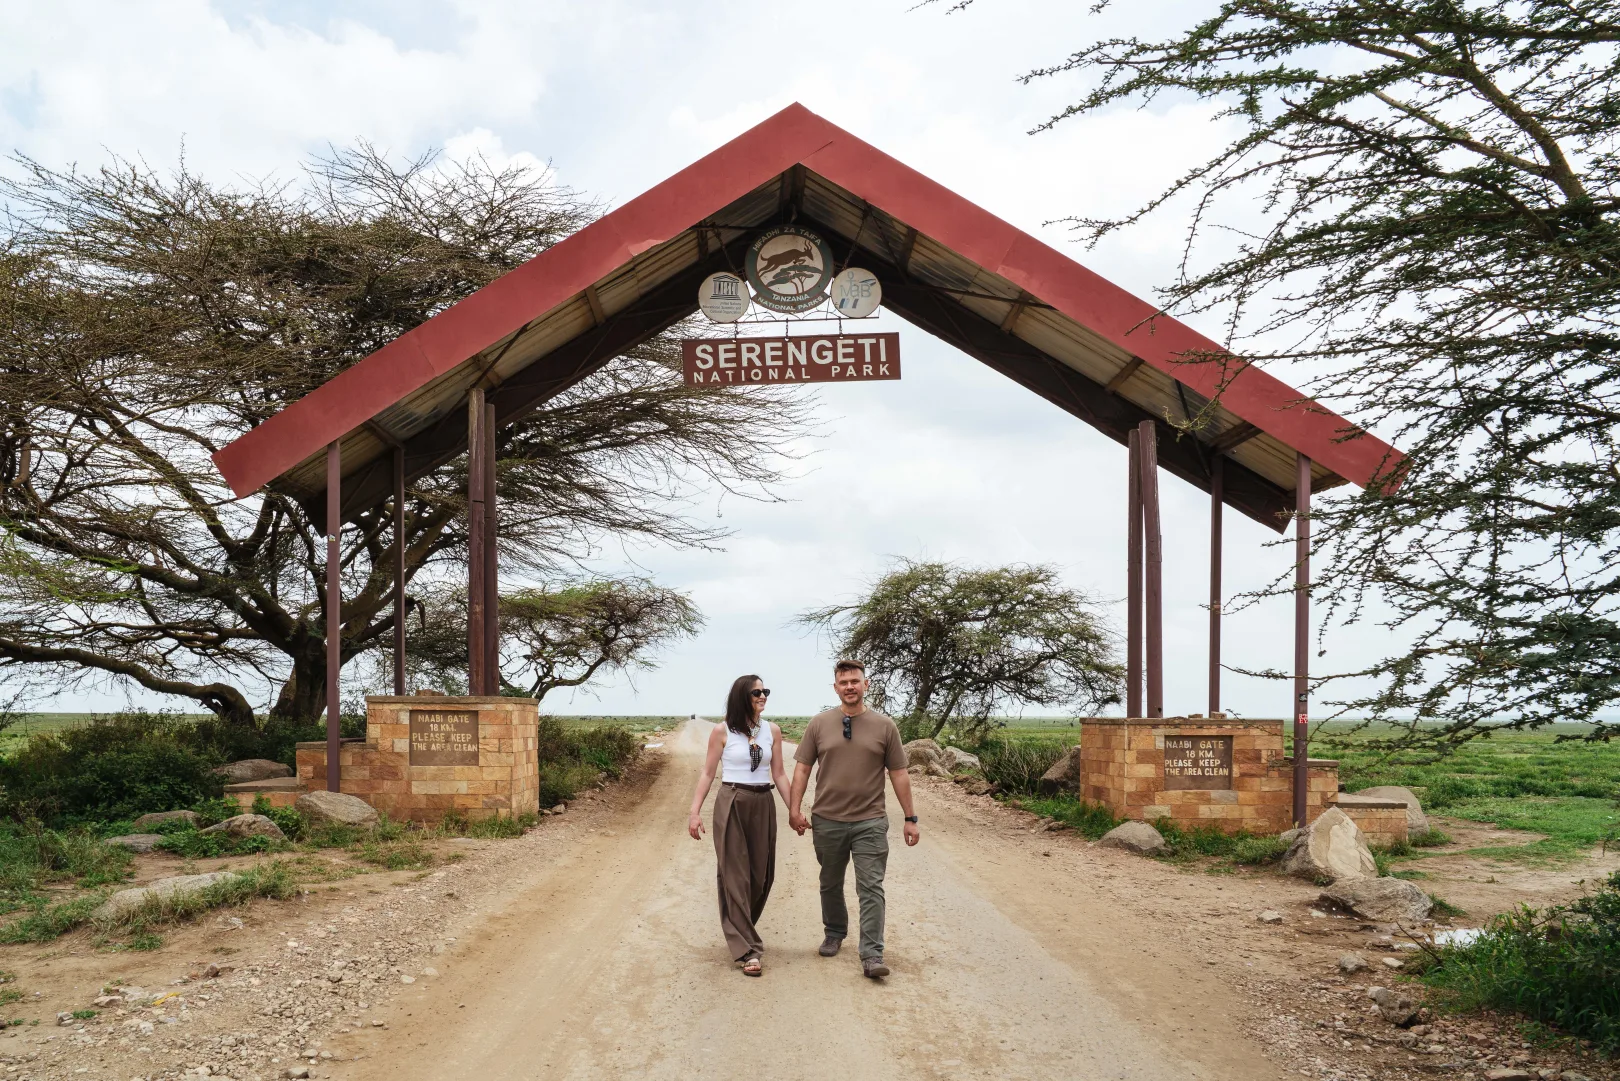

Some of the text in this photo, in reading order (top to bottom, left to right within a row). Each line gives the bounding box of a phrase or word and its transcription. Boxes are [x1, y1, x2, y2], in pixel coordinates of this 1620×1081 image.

[753, 228, 779, 251] HIFADHI
[800, 229, 822, 245] TAIFA
[772, 293, 810, 302] TANZANIA
[757, 295, 823, 310] NATIONAL PARKS
[695, 338, 887, 369] SERENGETI
[693, 363, 890, 384] NATIONAL PARK
[418, 714, 470, 723] NAABI GATE
[429, 723, 439, 732] 18
[412, 733, 472, 742] PLEASE KEEP
[412, 742, 478, 752] THE AREA CLEAN
[1165, 740, 1225, 749] NAABI GATE
[1185, 750, 1196, 758] 18
[1164, 759, 1221, 767] PLEASE KEEP
[1164, 768, 1229, 776] THE AREA CLEAN
